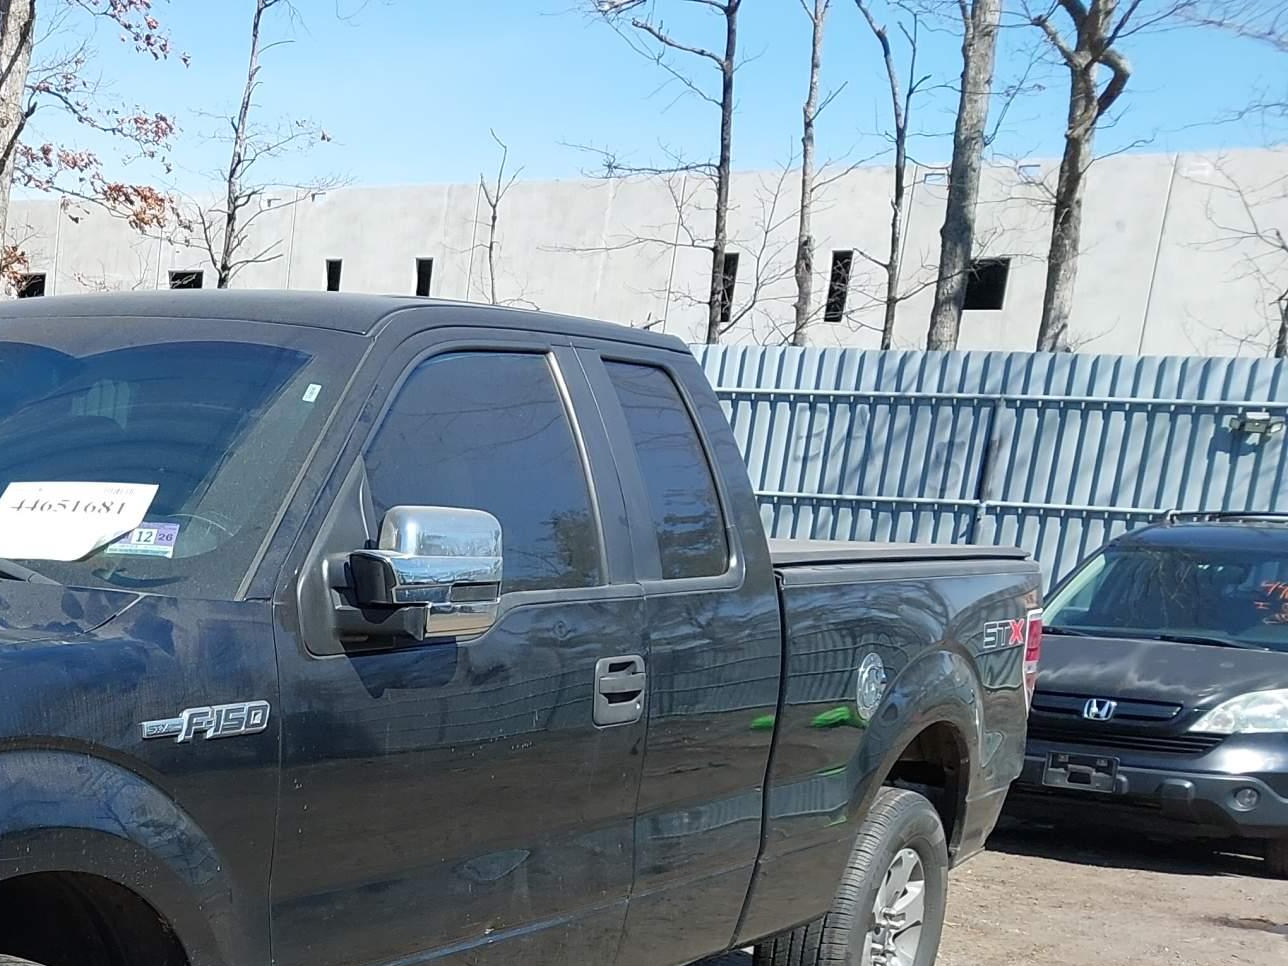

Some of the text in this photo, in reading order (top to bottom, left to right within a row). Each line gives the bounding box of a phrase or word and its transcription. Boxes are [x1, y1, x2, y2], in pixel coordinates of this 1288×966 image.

[9, 499, 126, 515] 44651681
[135, 531, 153, 543] 12
[158, 533, 173, 542] 26
[983, 618, 1025, 649] STX
